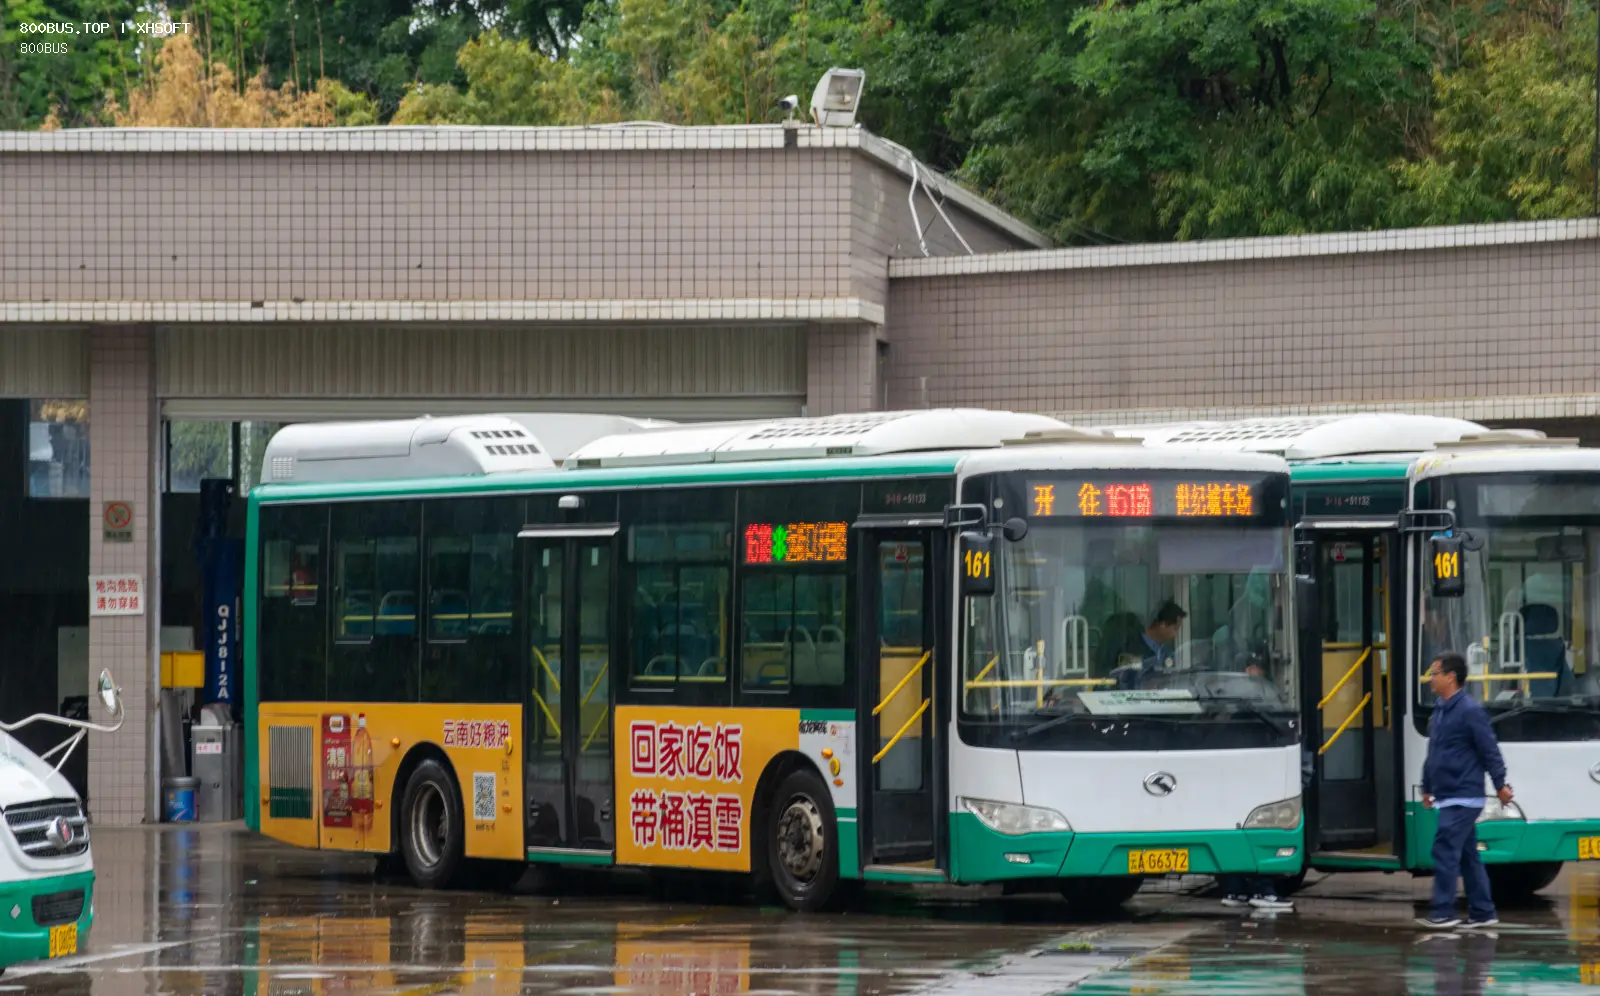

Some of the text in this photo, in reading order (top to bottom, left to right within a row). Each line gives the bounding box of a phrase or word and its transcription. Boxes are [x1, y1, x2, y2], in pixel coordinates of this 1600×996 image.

[964, 549, 991, 579] 161
[1434, 551, 1458, 579] 161
[96, 579, 138, 593] 地沟危险
[96, 596, 139, 610] 请勿穿越
[443, 719, 510, 749] 云南好粮油
[630, 721, 743, 783] 回家吃饭
[630, 790, 743, 852] 带桶滇雪
